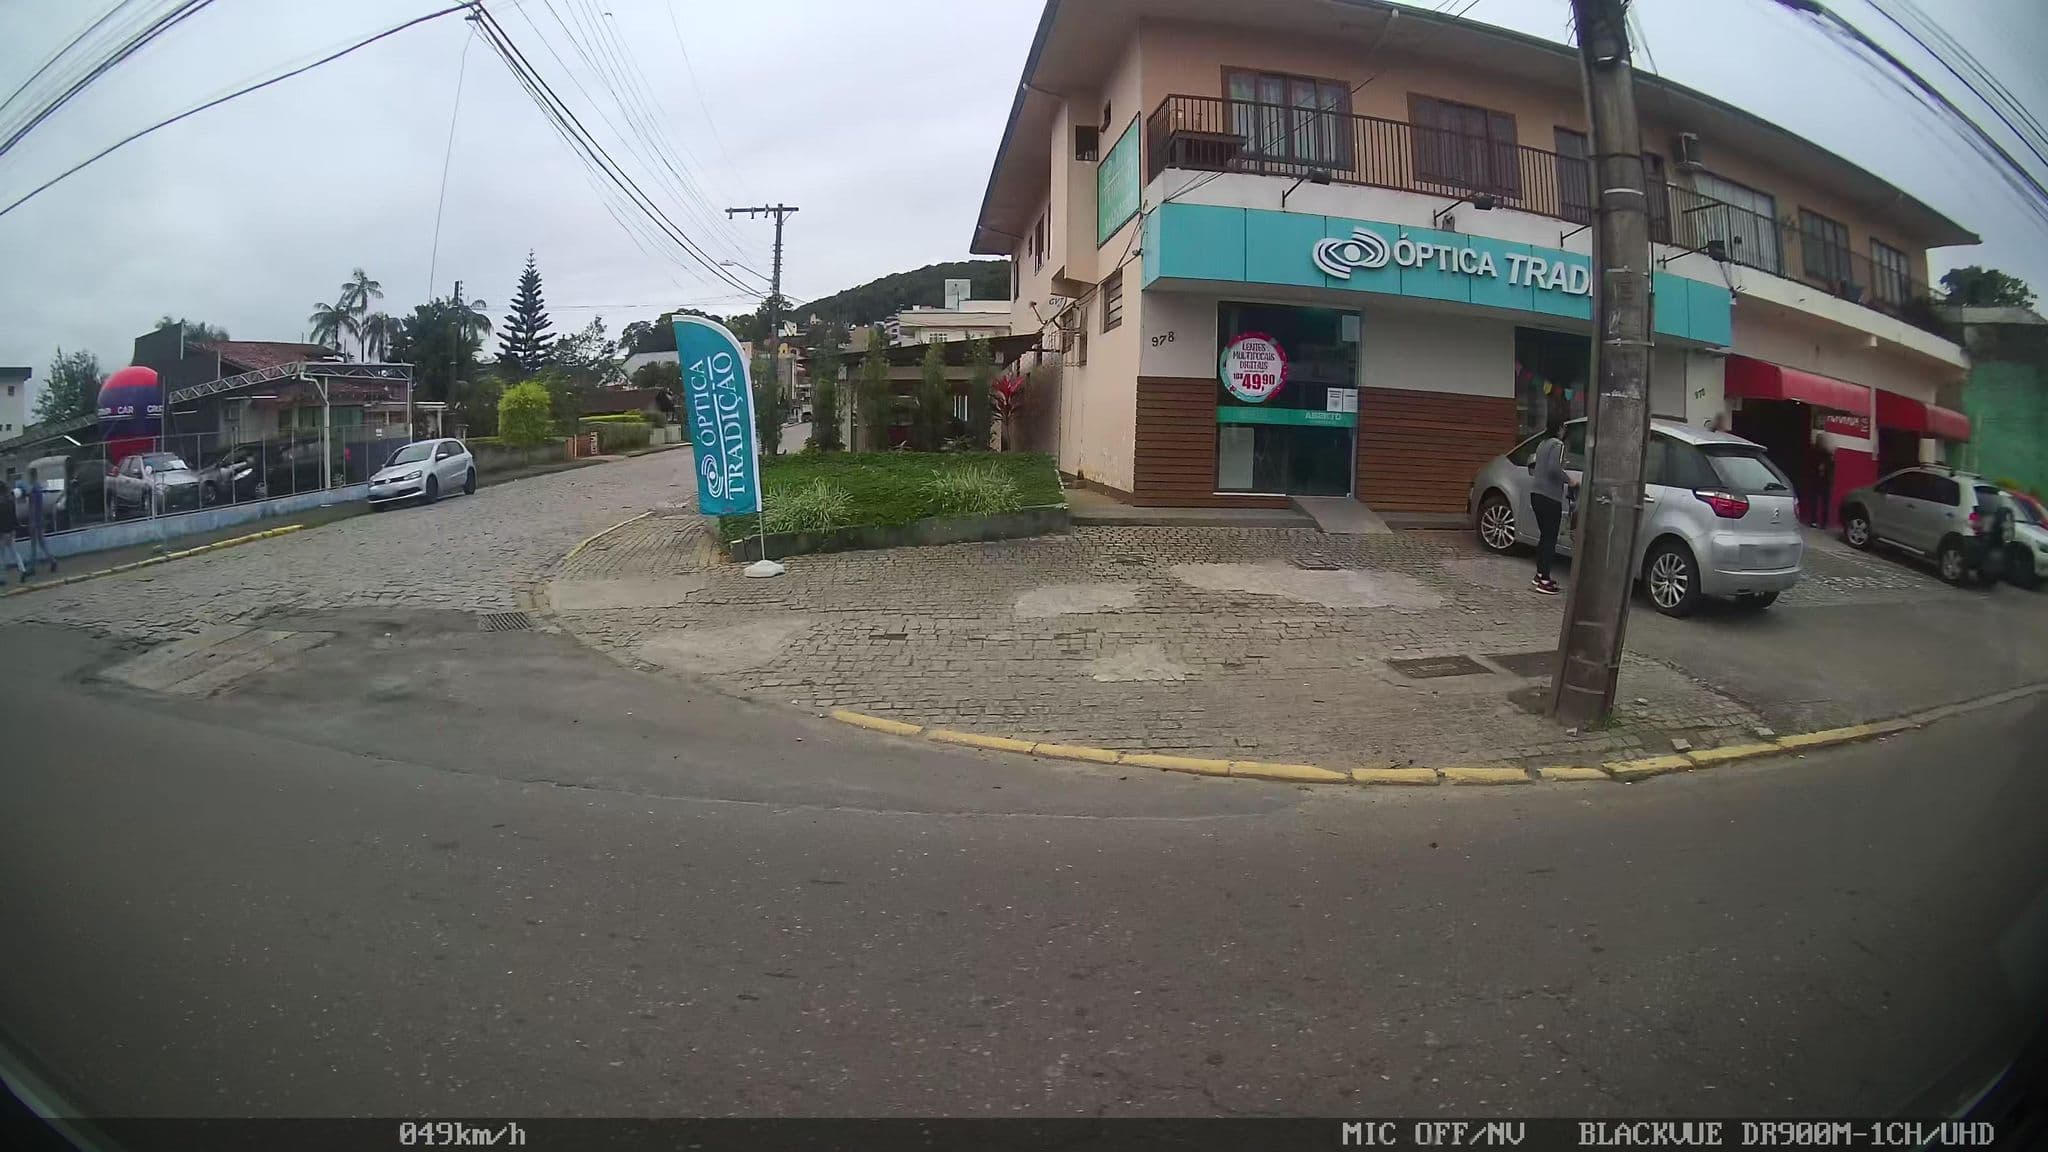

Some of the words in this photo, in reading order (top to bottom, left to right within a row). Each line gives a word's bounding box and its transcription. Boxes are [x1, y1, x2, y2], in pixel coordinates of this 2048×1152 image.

[1393, 233, 1498, 278] ÓPTICA
[1152, 331, 1174, 347] 978
[689, 359, 716, 446] ÓPTICA
[712, 352, 745, 500] TRADIÇÃO
